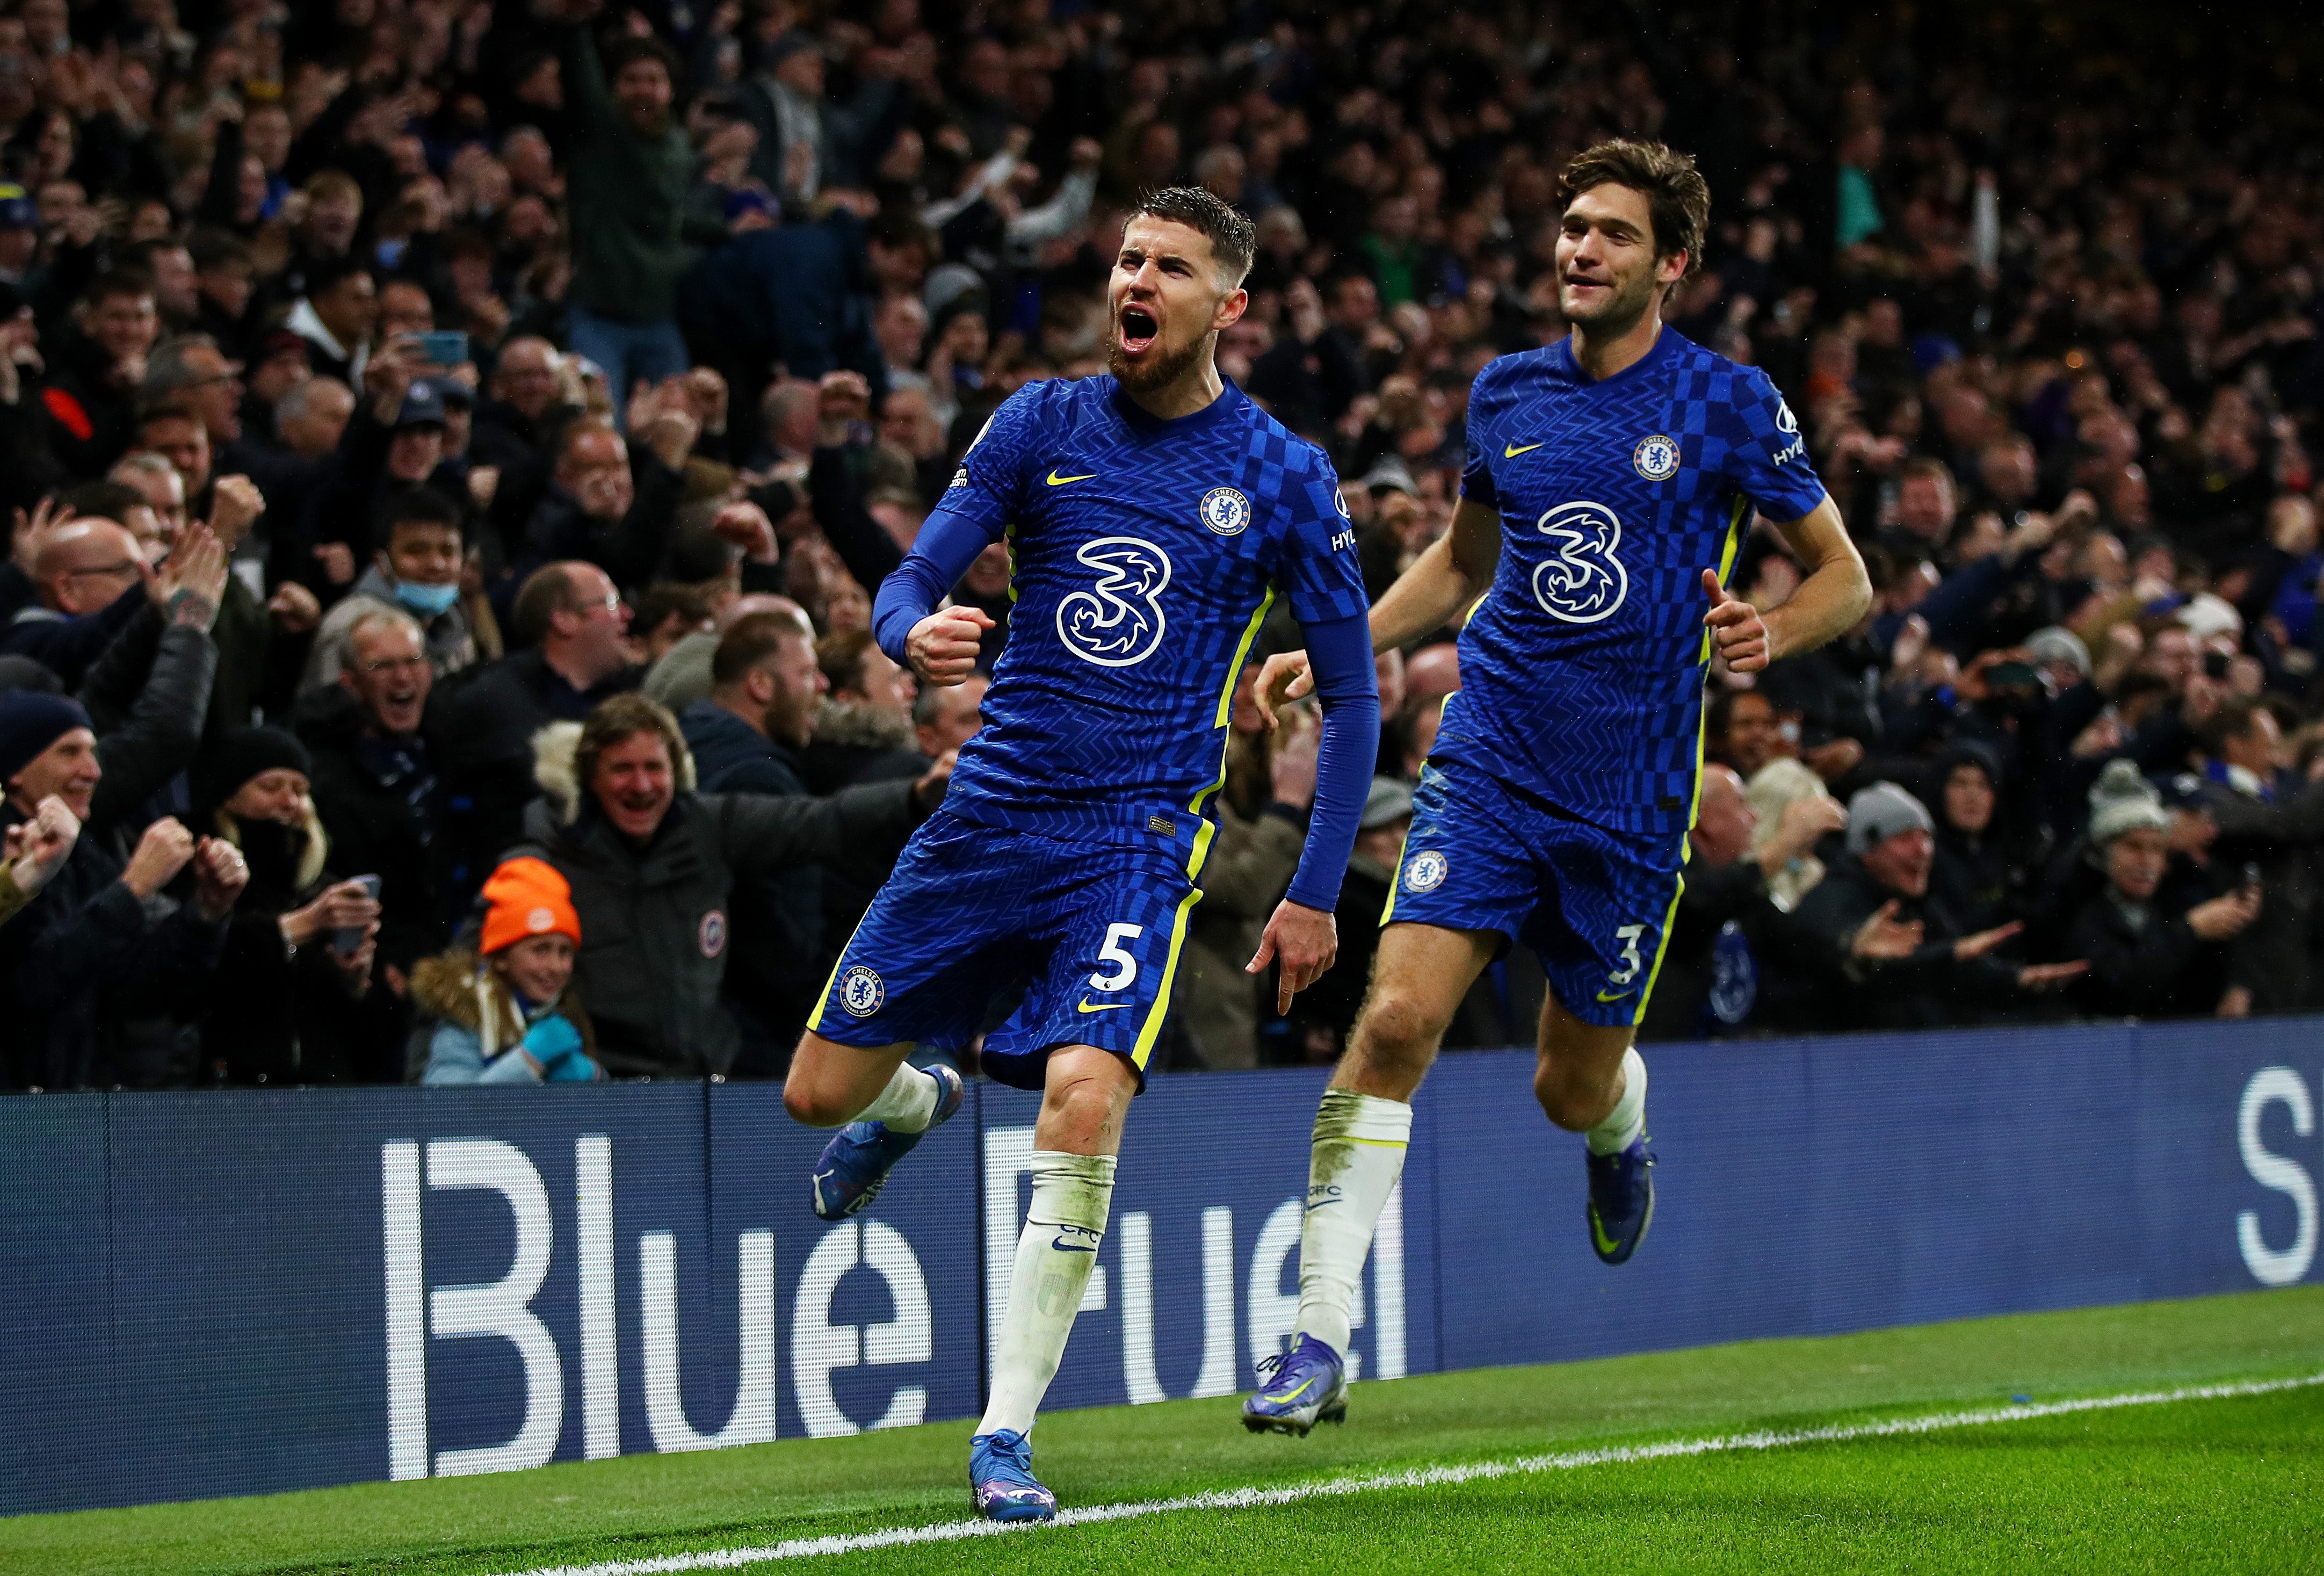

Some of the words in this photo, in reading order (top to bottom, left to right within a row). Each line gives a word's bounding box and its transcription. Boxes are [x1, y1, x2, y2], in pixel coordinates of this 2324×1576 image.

[1205, 517, 1225, 533] FOOTBALL
[1214, 489, 1246, 506] CHELSEA
[1532, 501, 1628, 624] 3
[1056, 537, 1171, 667] 3
[851, 968, 879, 985] CHELSEA
[1089, 923, 1144, 992] 5
[1609, 924, 1647, 985] 3
[843, 999, 859, 1014] FOOTBALL
[382, 1131, 933, 1481] Blue
